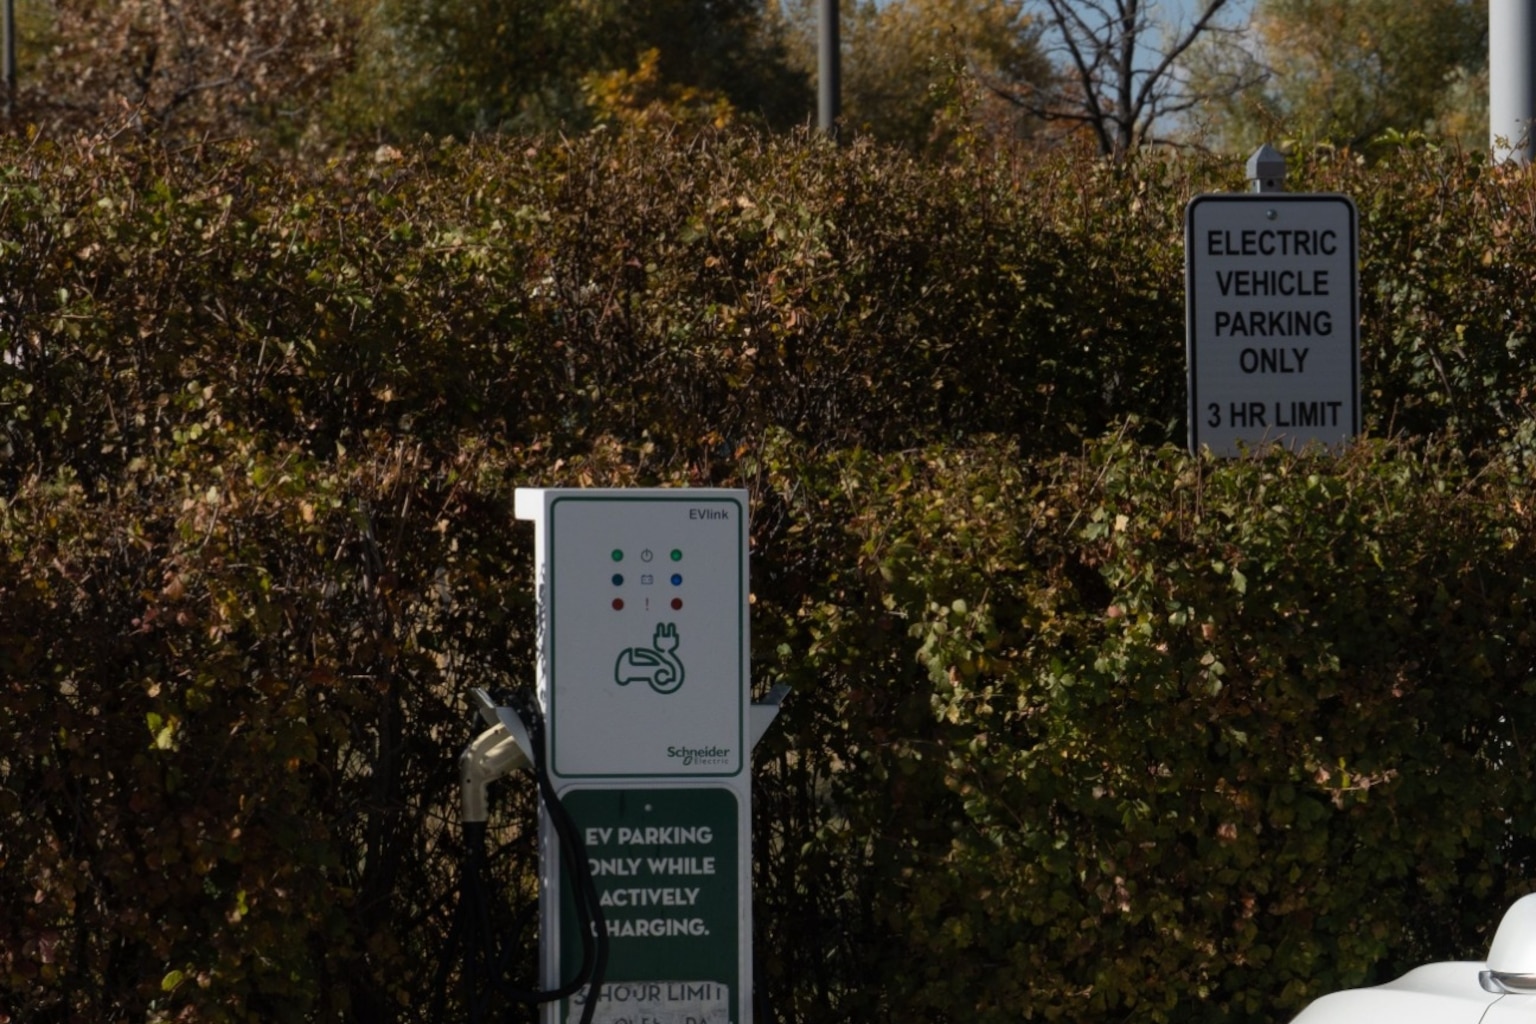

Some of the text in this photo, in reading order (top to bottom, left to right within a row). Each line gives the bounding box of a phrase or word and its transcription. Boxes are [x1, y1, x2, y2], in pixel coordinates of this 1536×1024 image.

[1207, 229, 1337, 256] ELECTRIC
[1215, 270, 1329, 297] VEHICLE
[1214, 310, 1333, 337] PARKING
[1239, 347, 1309, 374] ONLY
[1207, 401, 1343, 429] 3 HR LIMIT
[689, 508, 729, 520] EVlink
[667, 746, 730, 758] Schneider
[694, 757, 729, 765] Electric
[585, 826, 713, 846] EV PARKING
[588, 857, 716, 876] ONLY WHILE
[599, 887, 700, 907] ACTIVELY
[598, 983, 661, 1002] HOUR
